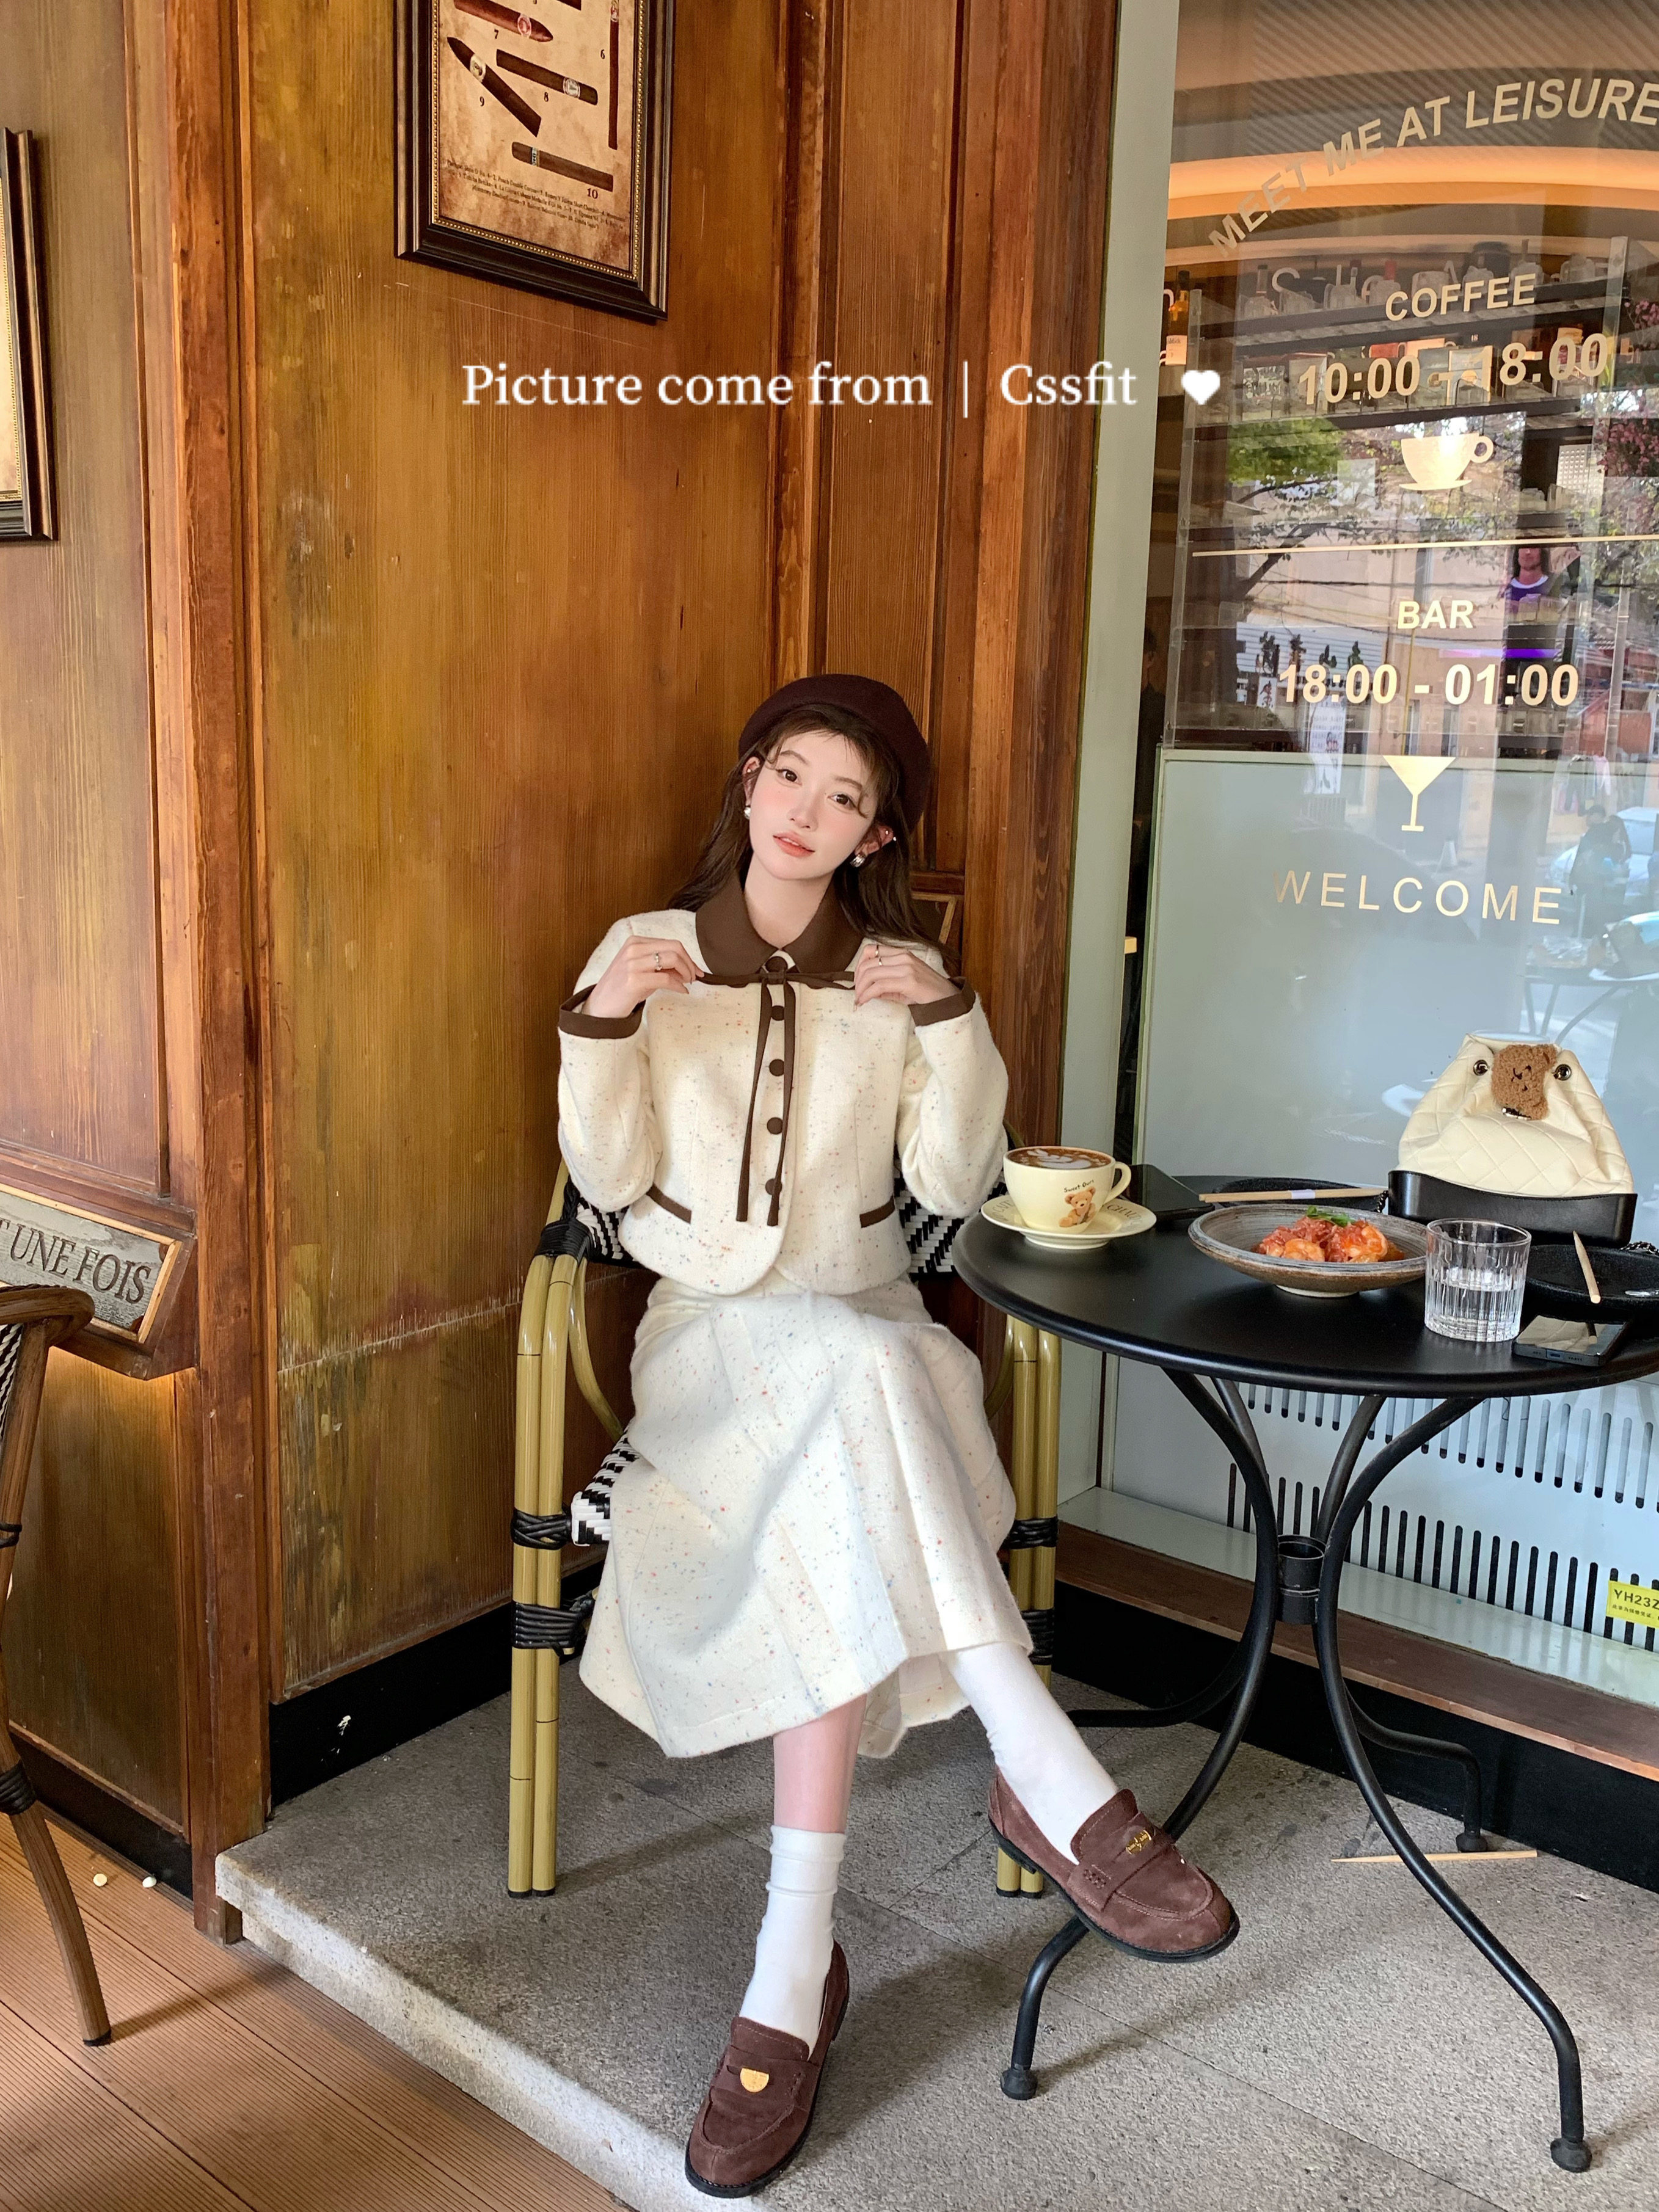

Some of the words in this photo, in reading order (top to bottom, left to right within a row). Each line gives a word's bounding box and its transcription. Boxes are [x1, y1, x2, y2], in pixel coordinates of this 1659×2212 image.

[494, 29, 499, 40] 7
[600, 49, 605, 60] 6
[479, 96, 485, 107] 9
[543, 92, 550, 102] 8
[1208, 156, 1308, 257] MEET
[1322, 118, 1384, 176] ME
[1396, 96, 1451, 148] AT
[1464, 77, 1659, 129] LEISURE
[586, 187, 599, 200] 10
[1385, 272, 1537, 322] COFFEE
[1298, 355, 1420, 406] 10:00
[1469, 332, 1608, 402] 18:00
[1398, 600, 1475, 630] BAR
[1279, 663, 1398, 704] 18:00
[1445, 663, 1579, 706] 01:00
[1274, 870, 1562, 925] WELCOME
[1063, 1184, 1081, 1193] Sweet
[10, 1223, 76, 1278] UNE
[73, 1246, 152, 1304] FOIS
